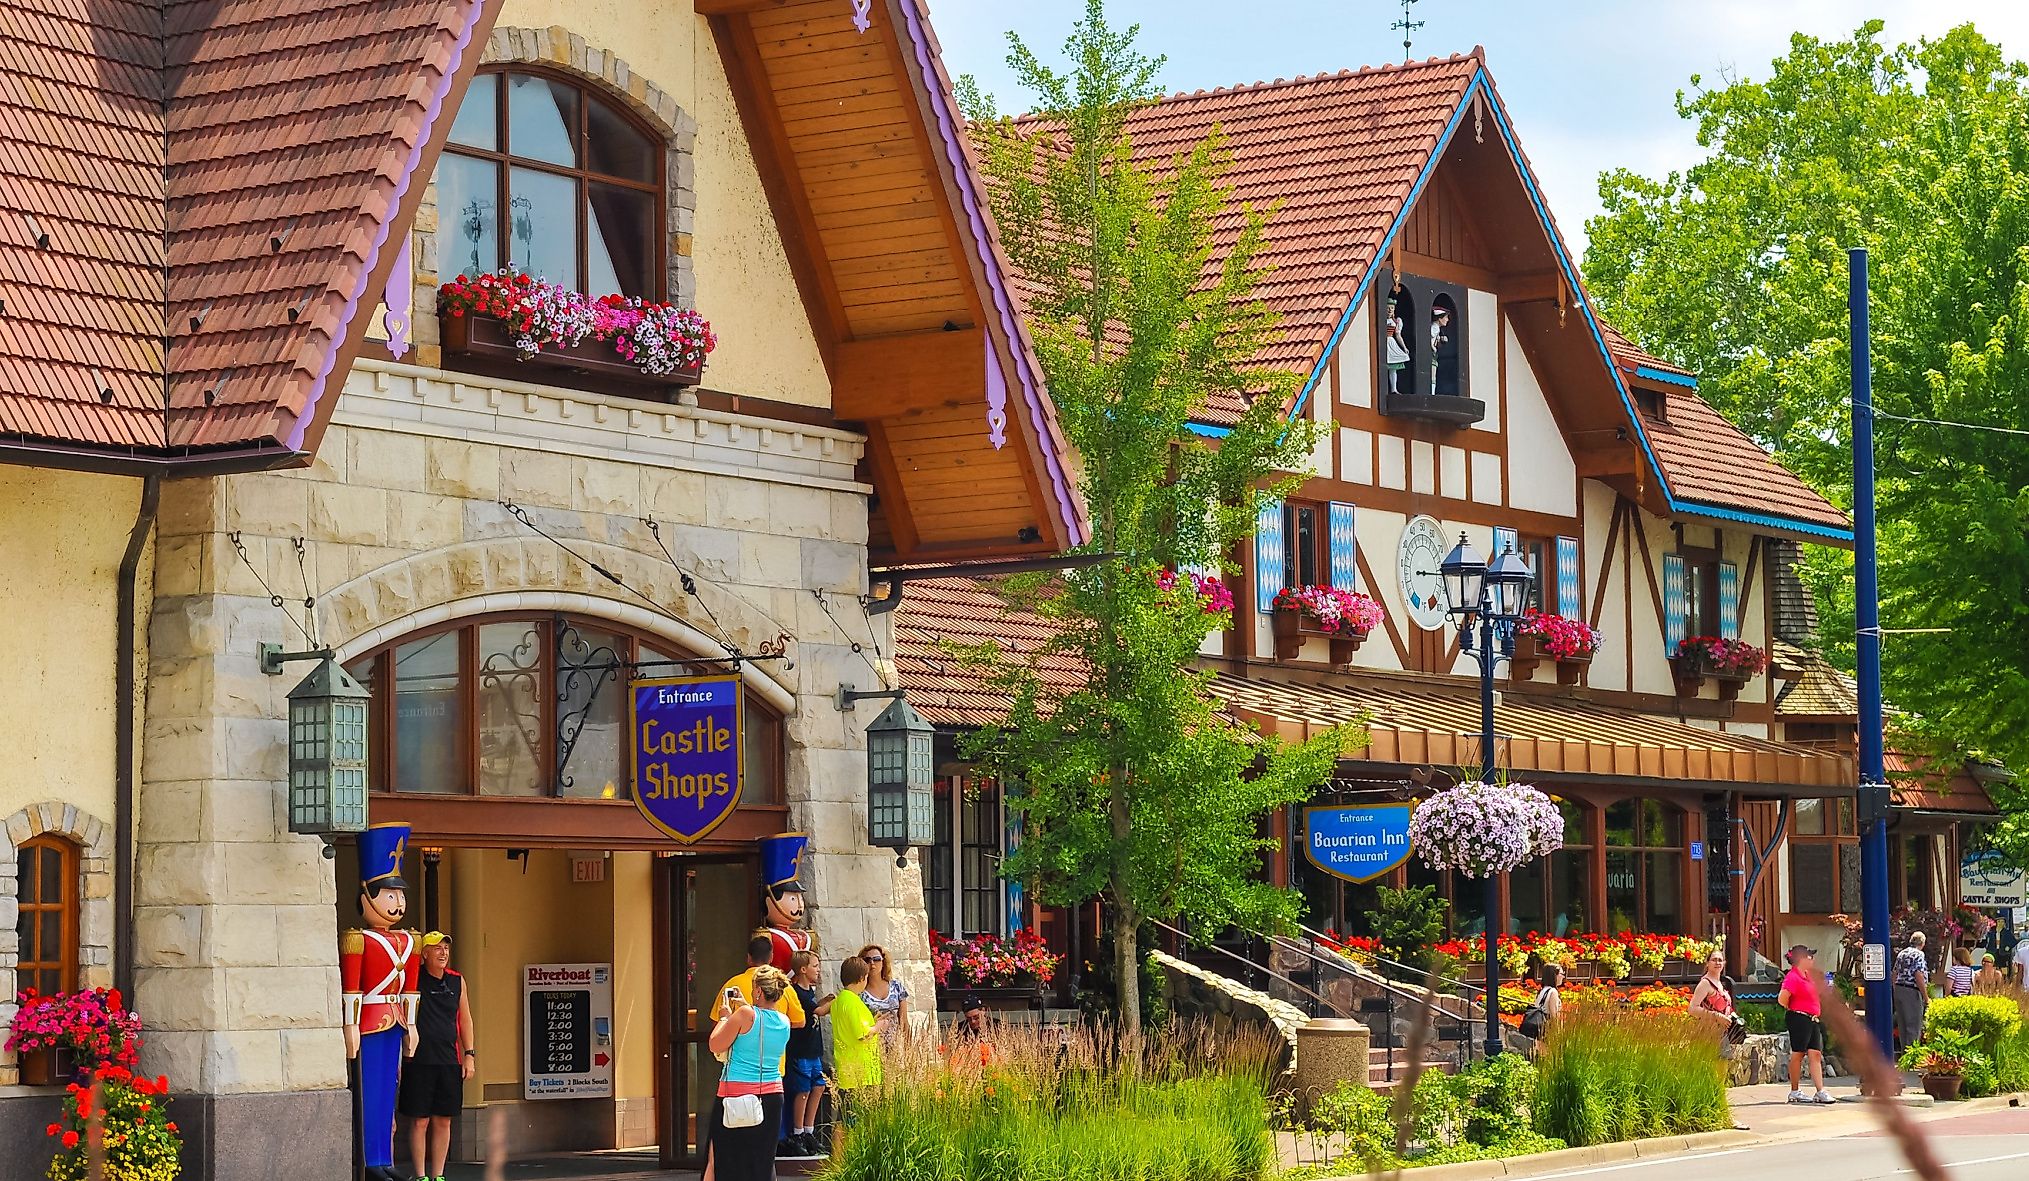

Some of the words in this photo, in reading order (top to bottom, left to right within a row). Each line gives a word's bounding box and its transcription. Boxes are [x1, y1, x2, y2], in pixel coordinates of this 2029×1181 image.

[1419, 523, 1425, 531] 50
[658, 689, 713, 704] Entrance
[642, 715, 730, 755] Castle
[645, 762, 730, 811] Shops
[1339, 813, 1374, 823] Entrance
[1314, 831, 1376, 848] Bavarian
[1382, 828, 1405, 845] Inn
[1330, 849, 1389, 863] Restaurant
[576, 860, 602, 881] EXIT
[1962, 896, 1991, 904] CASTLE
[1994, 896, 2020, 904] SHOPS
[528, 968, 591, 981] Riverboat
[547, 1002, 572, 1010] 11:00
[547, 1011, 572, 1020] 12:30
[547, 1021, 572, 1030] 2:00
[547, 1031, 572, 1041] 3:30
[547, 1042, 572, 1051] 5:00
[547, 1052, 572, 1062] 6:30
[547, 1063, 572, 1072] 8:00
[529, 1079, 541, 1087] Buy
[542, 1078, 564, 1086] Tickets
